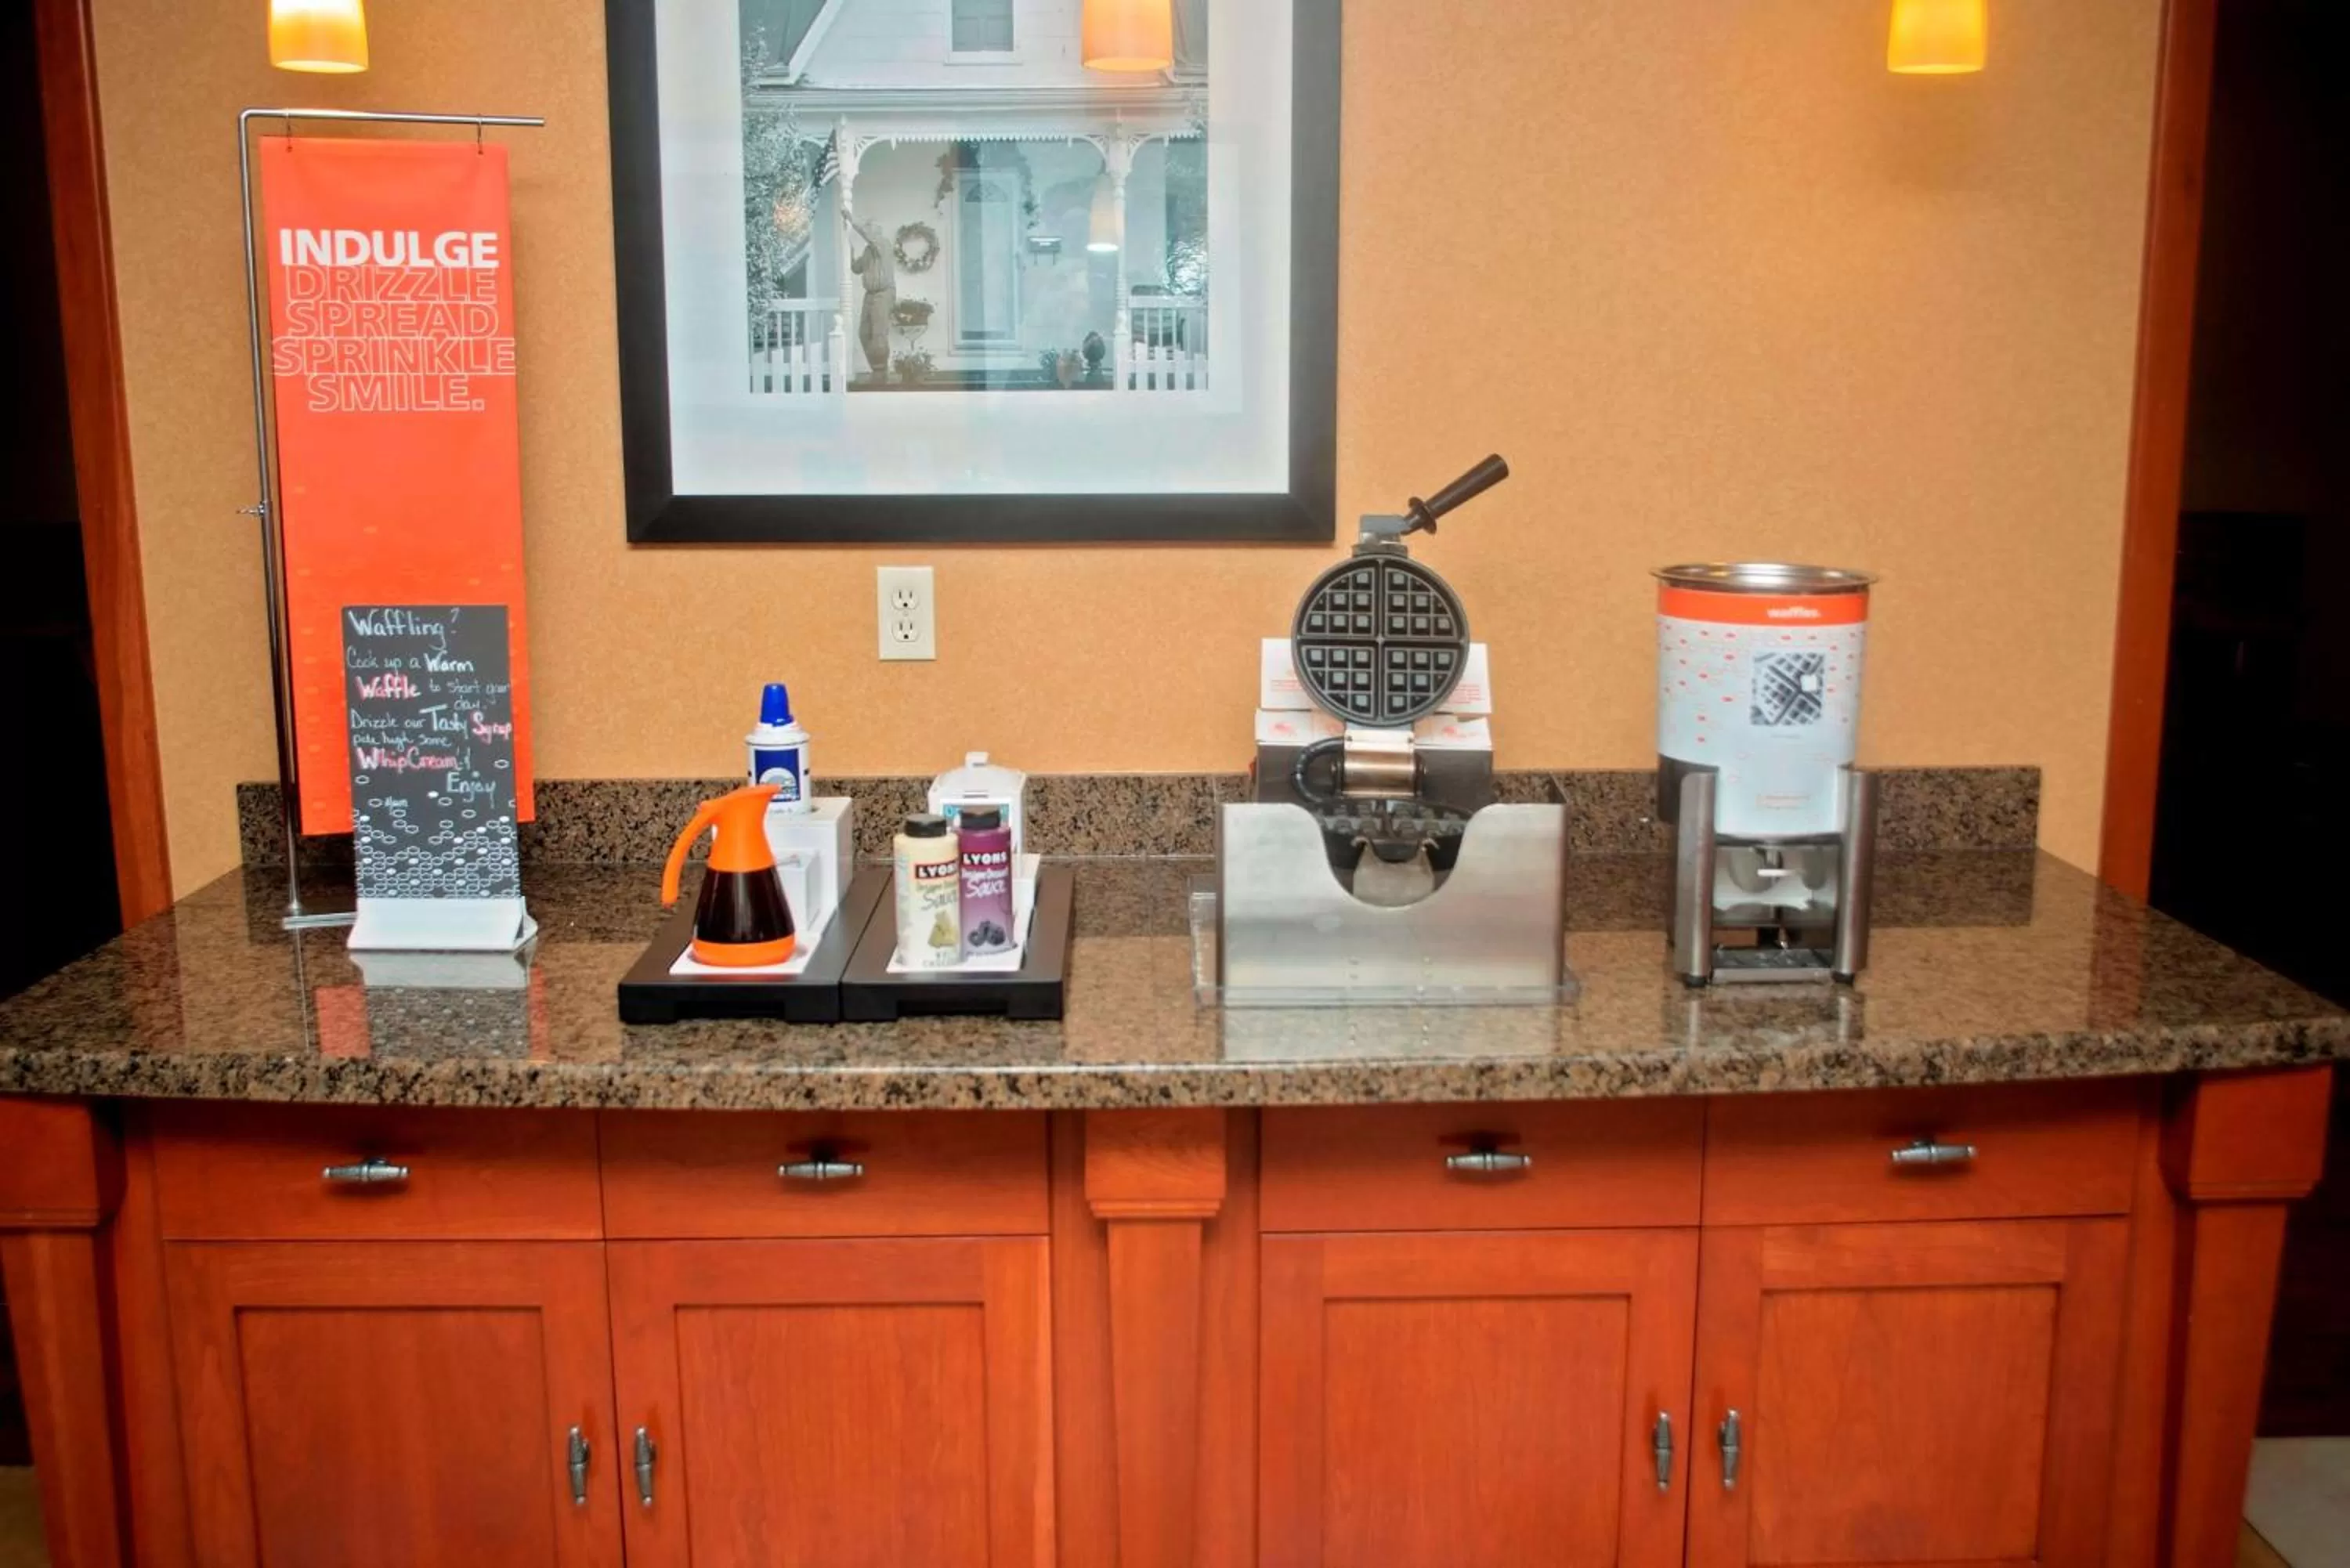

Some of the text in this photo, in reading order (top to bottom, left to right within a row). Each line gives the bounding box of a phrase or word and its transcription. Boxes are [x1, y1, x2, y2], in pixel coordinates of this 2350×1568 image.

[280, 229, 499, 269] INDULGE
[285, 264, 497, 304] DRIZZLE
[286, 301, 499, 339] SPREAD
[273, 338, 516, 375] SPRINKLE
[308, 374, 485, 412] SMILE.
[384, 657, 402, 675] up
[410, 658, 421, 669] a
[424, 649, 474, 673] Warm
[355, 673, 421, 700] Waffle
[430, 679, 441, 693] to
[351, 704, 512, 745] Drizzle our Tasty Syrup
[447, 771, 497, 809] Enjoy
[964, 851, 1007, 865] LYONS
